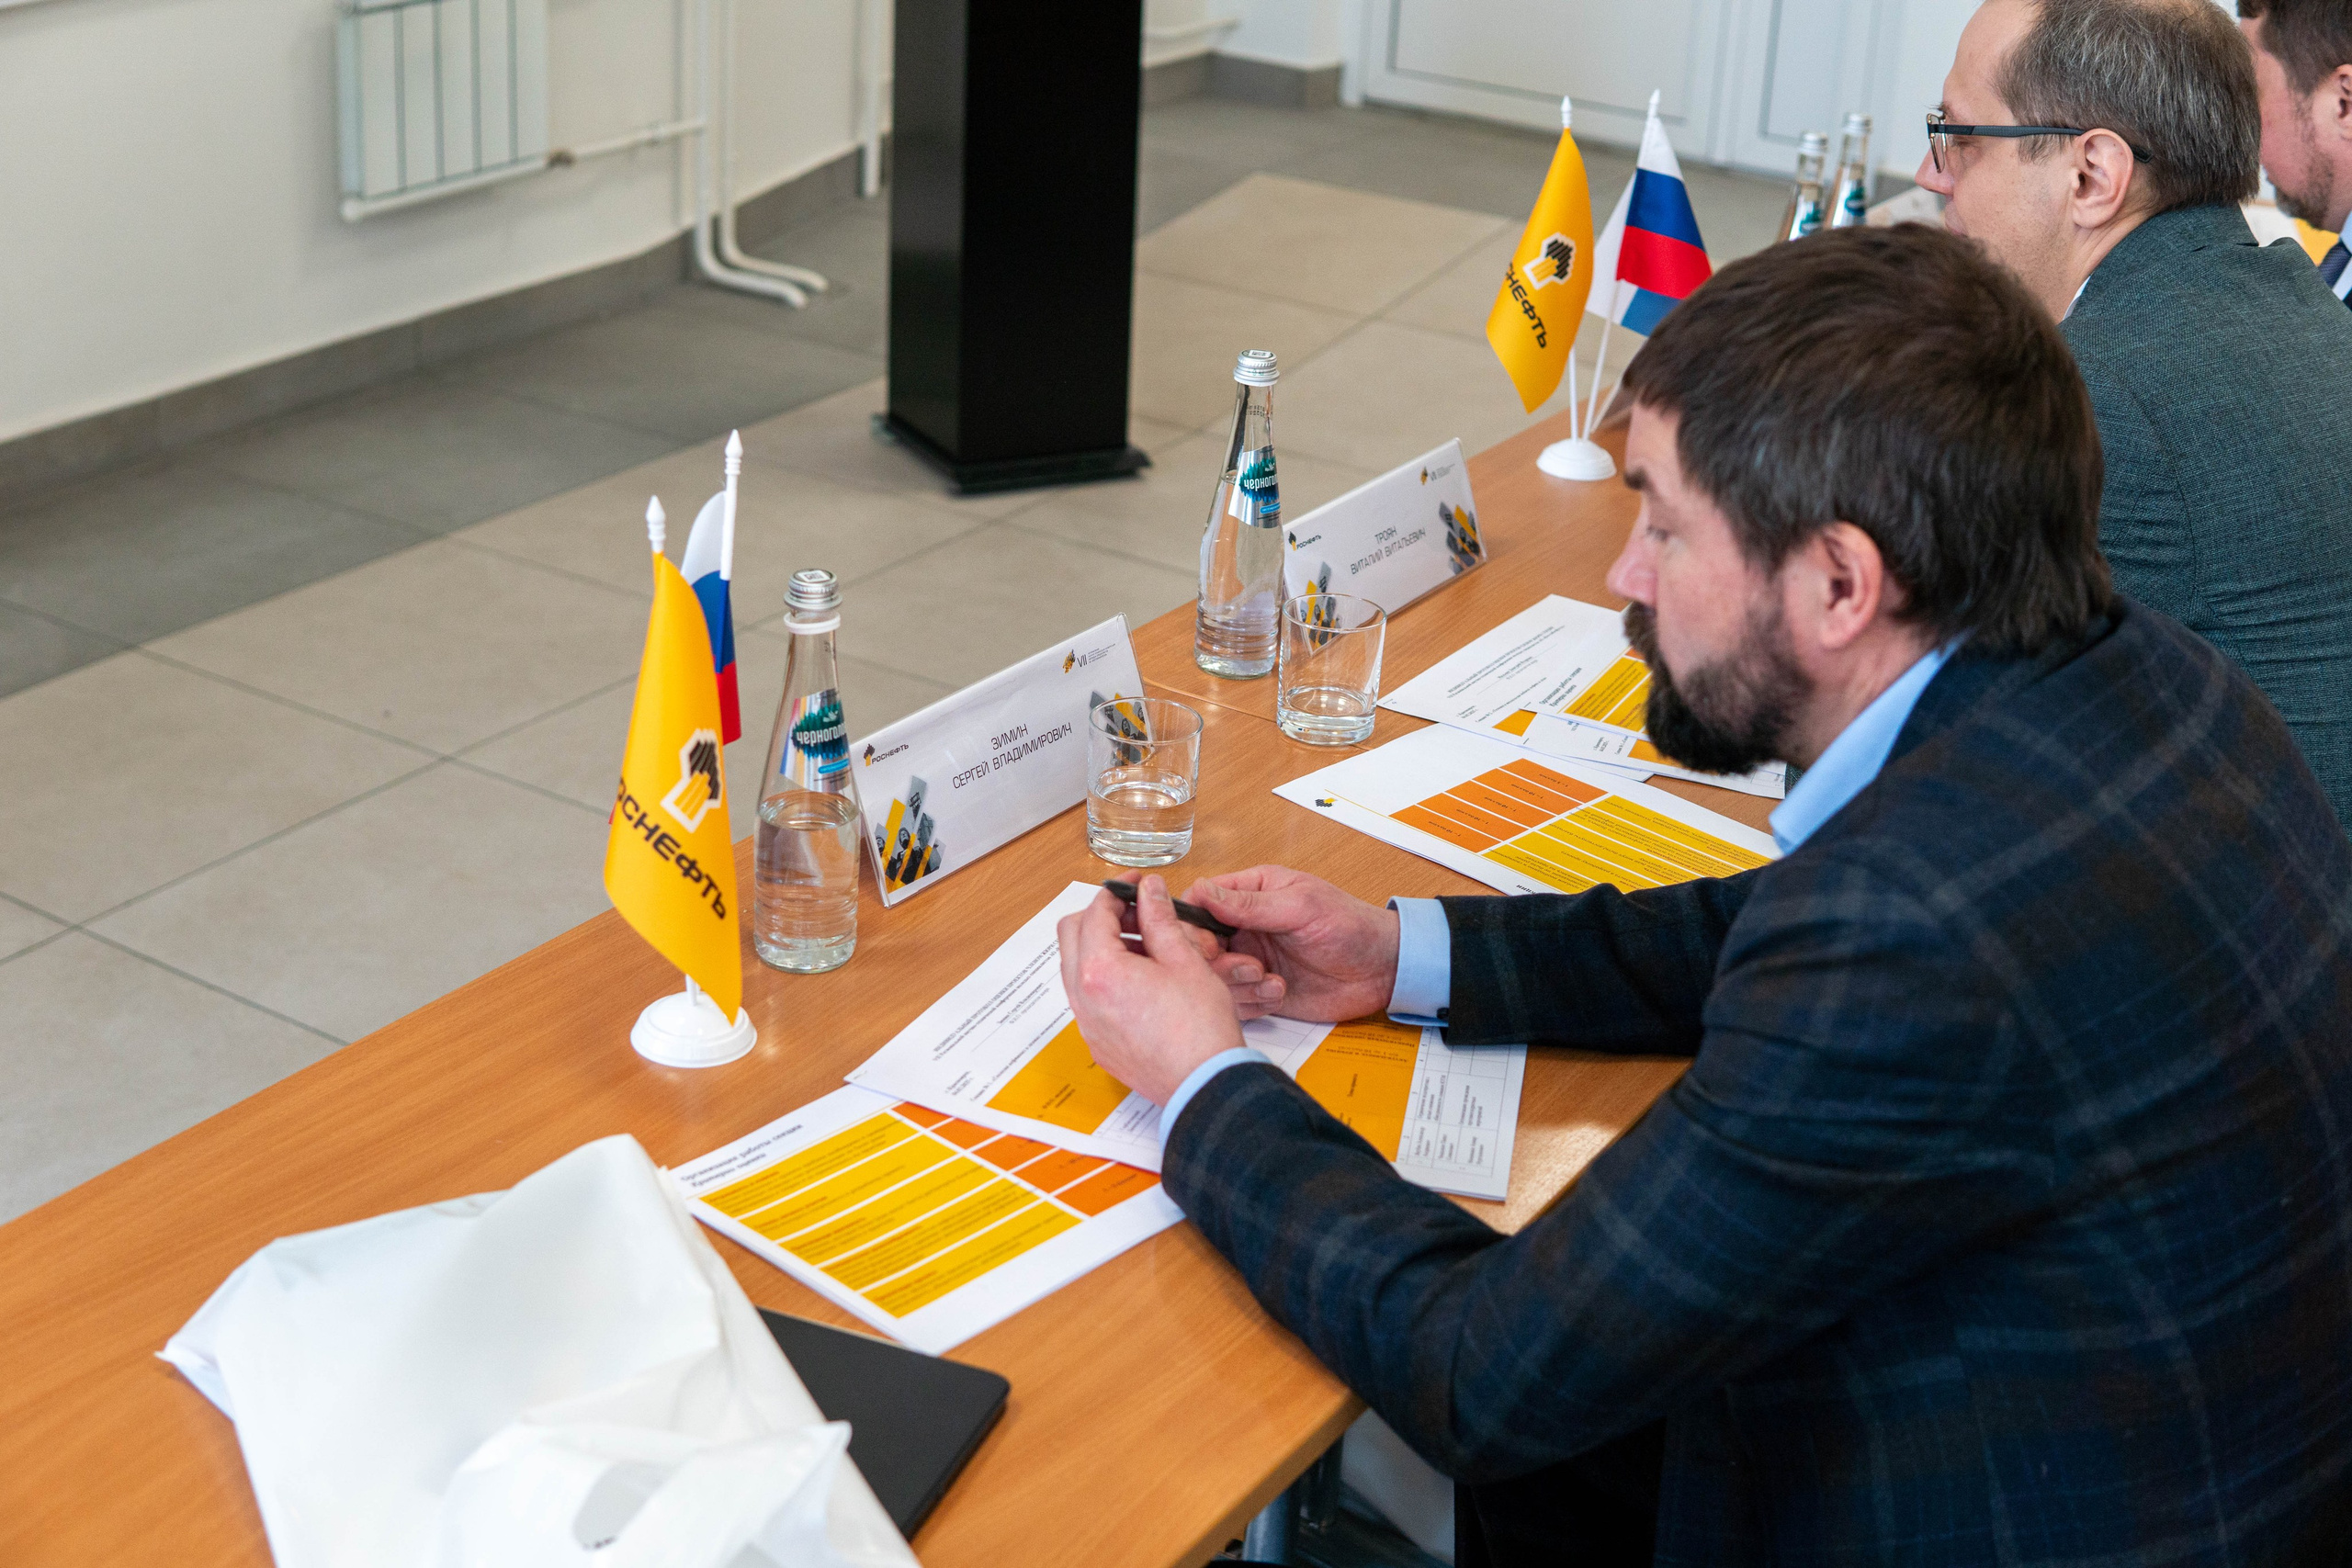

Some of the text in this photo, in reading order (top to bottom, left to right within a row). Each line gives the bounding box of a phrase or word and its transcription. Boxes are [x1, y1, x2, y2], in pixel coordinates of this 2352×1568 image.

[1351, 527, 1426, 574] ВИТАЛИЙ ВИТАЛЬЕВИЧ
[1375, 526, 1397, 544] ТРОЯН
[871, 743, 909, 763] РОСНЕФТЬ
[991, 724, 1028, 750] ЗИМИН
[953, 722, 1072, 789] СЕРГЕЙ ВЛАДИМИРОВИЧ
[616, 777, 727, 920] ОСНЕФТЬ
